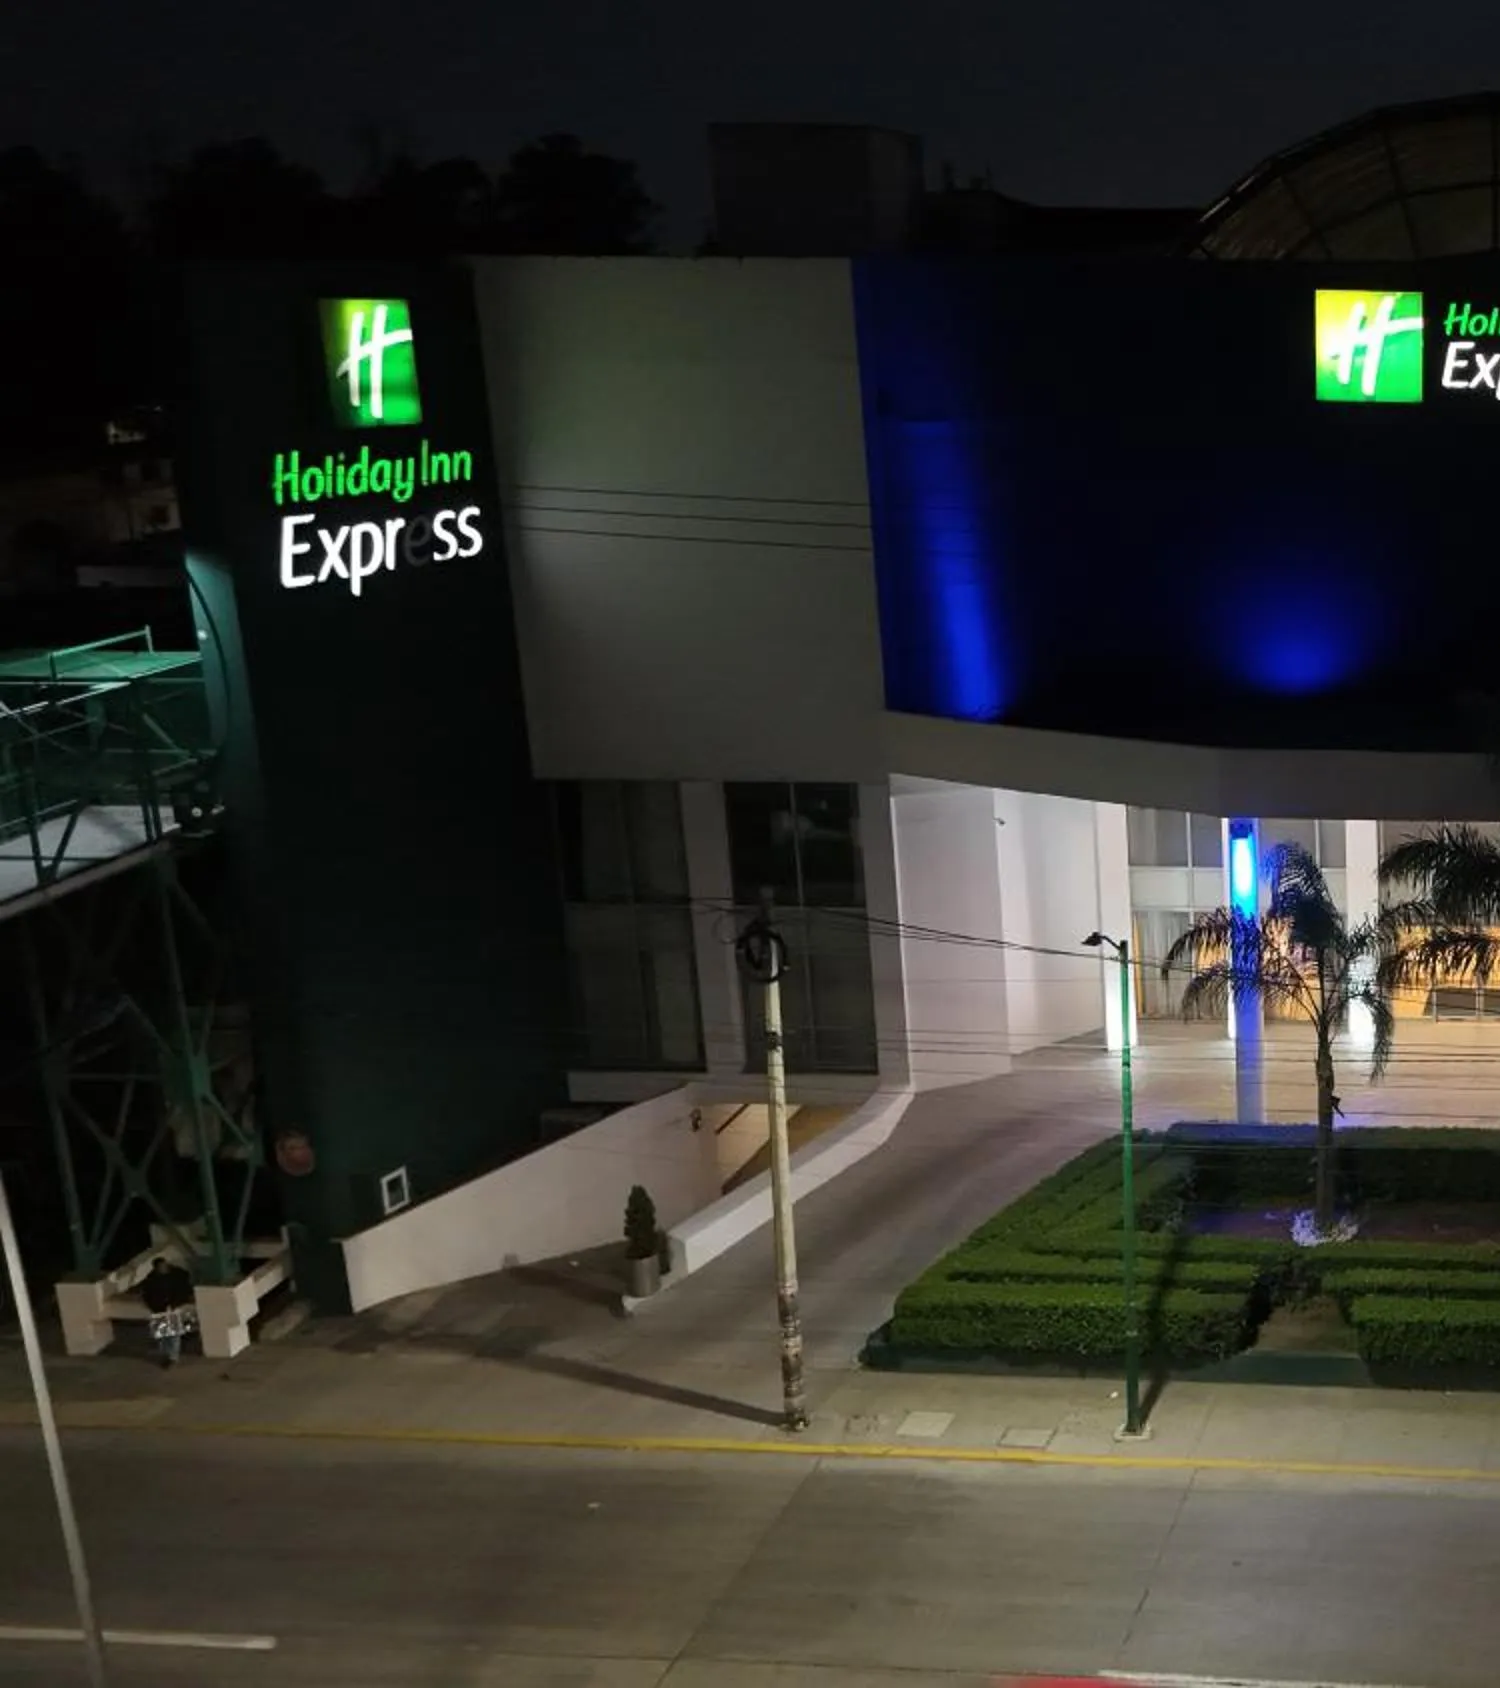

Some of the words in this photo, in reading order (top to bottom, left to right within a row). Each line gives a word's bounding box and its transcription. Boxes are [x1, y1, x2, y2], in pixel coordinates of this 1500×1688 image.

[336, 303, 414, 420] H
[1329, 293, 1424, 397] H
[272, 445, 415, 506] Holiday
[421, 439, 473, 487] Inn
[279, 505, 484, 597] Express
